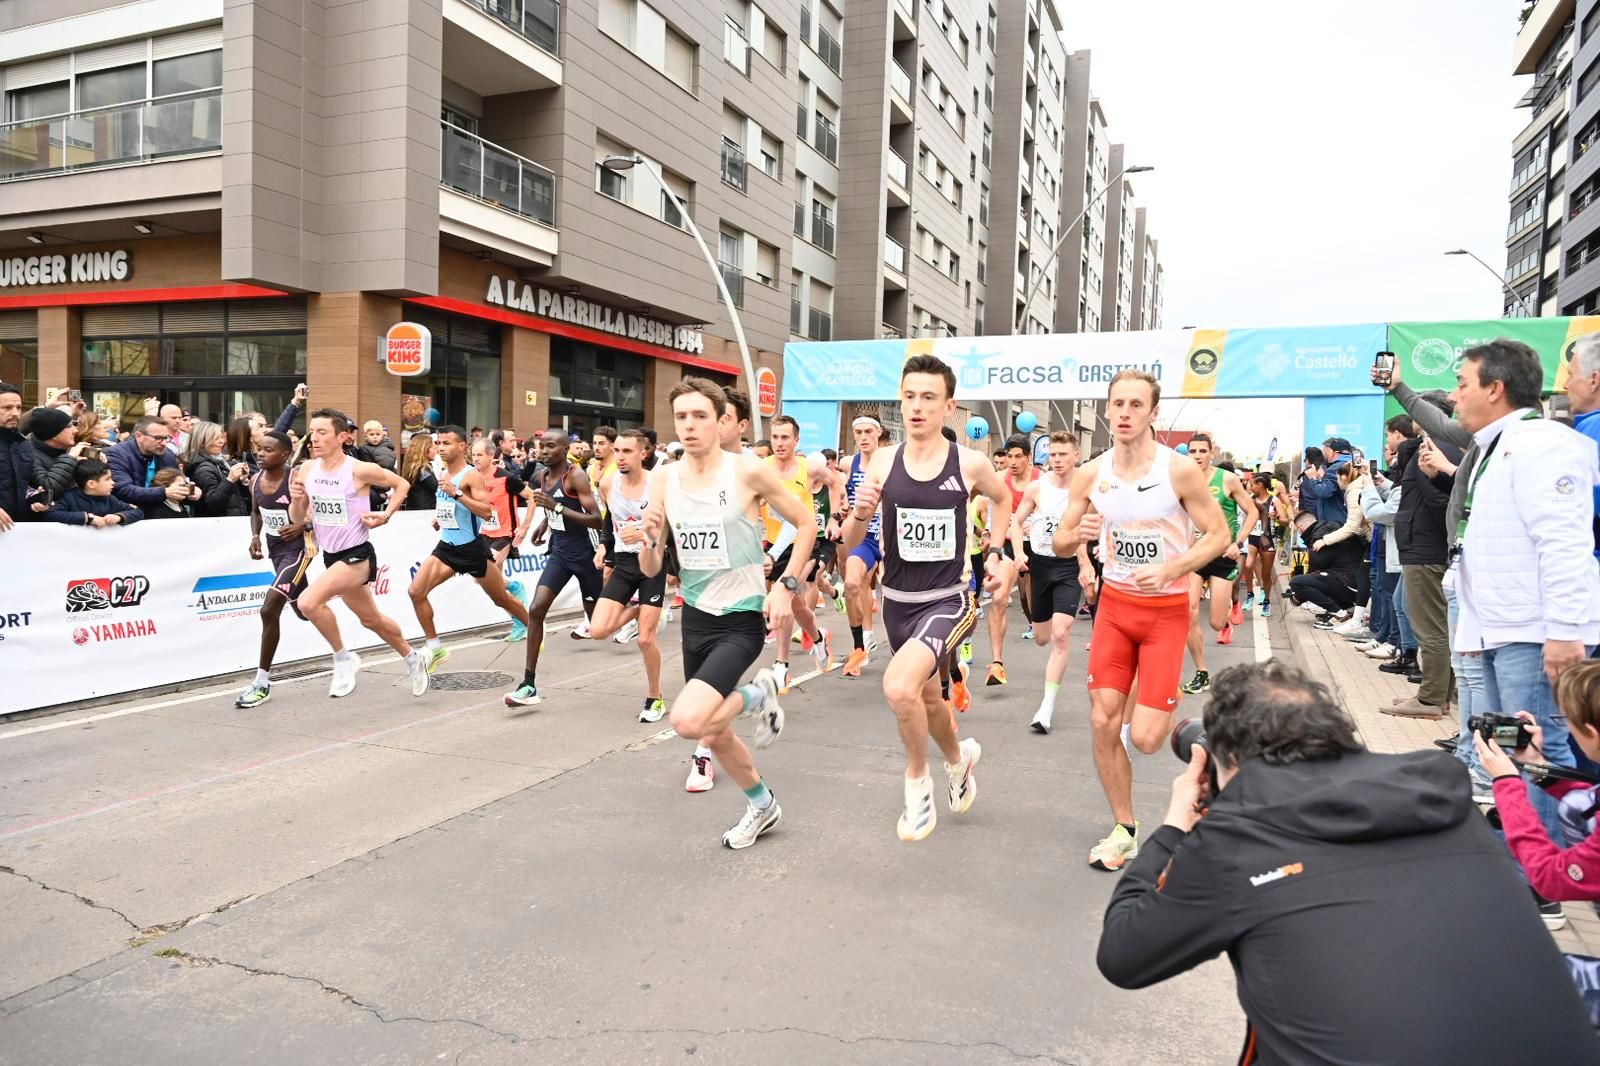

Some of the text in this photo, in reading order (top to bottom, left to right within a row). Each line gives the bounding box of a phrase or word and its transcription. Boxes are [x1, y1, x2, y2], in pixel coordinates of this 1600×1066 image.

[71, 250, 128, 282] KING
[486, 275, 704, 354] A LA PARRILLA DESDE 1954
[388, 340, 422, 350] BURGER
[387, 350, 421, 363] KING
[1294, 352, 1358, 369] Castelló
[314, 501, 342, 515] 2033
[680, 531, 720, 551] 2072
[903, 522, 947, 542] 2011
[909, 541, 941, 549] SCHRUB
[1115, 540, 1158, 559] 2009
[1124, 557, 1150, 565] DOUMA
[110, 575, 150, 608] C2P
[196, 593, 247, 610] ANDACAR
[90, 619, 157, 642] YAMAHA
